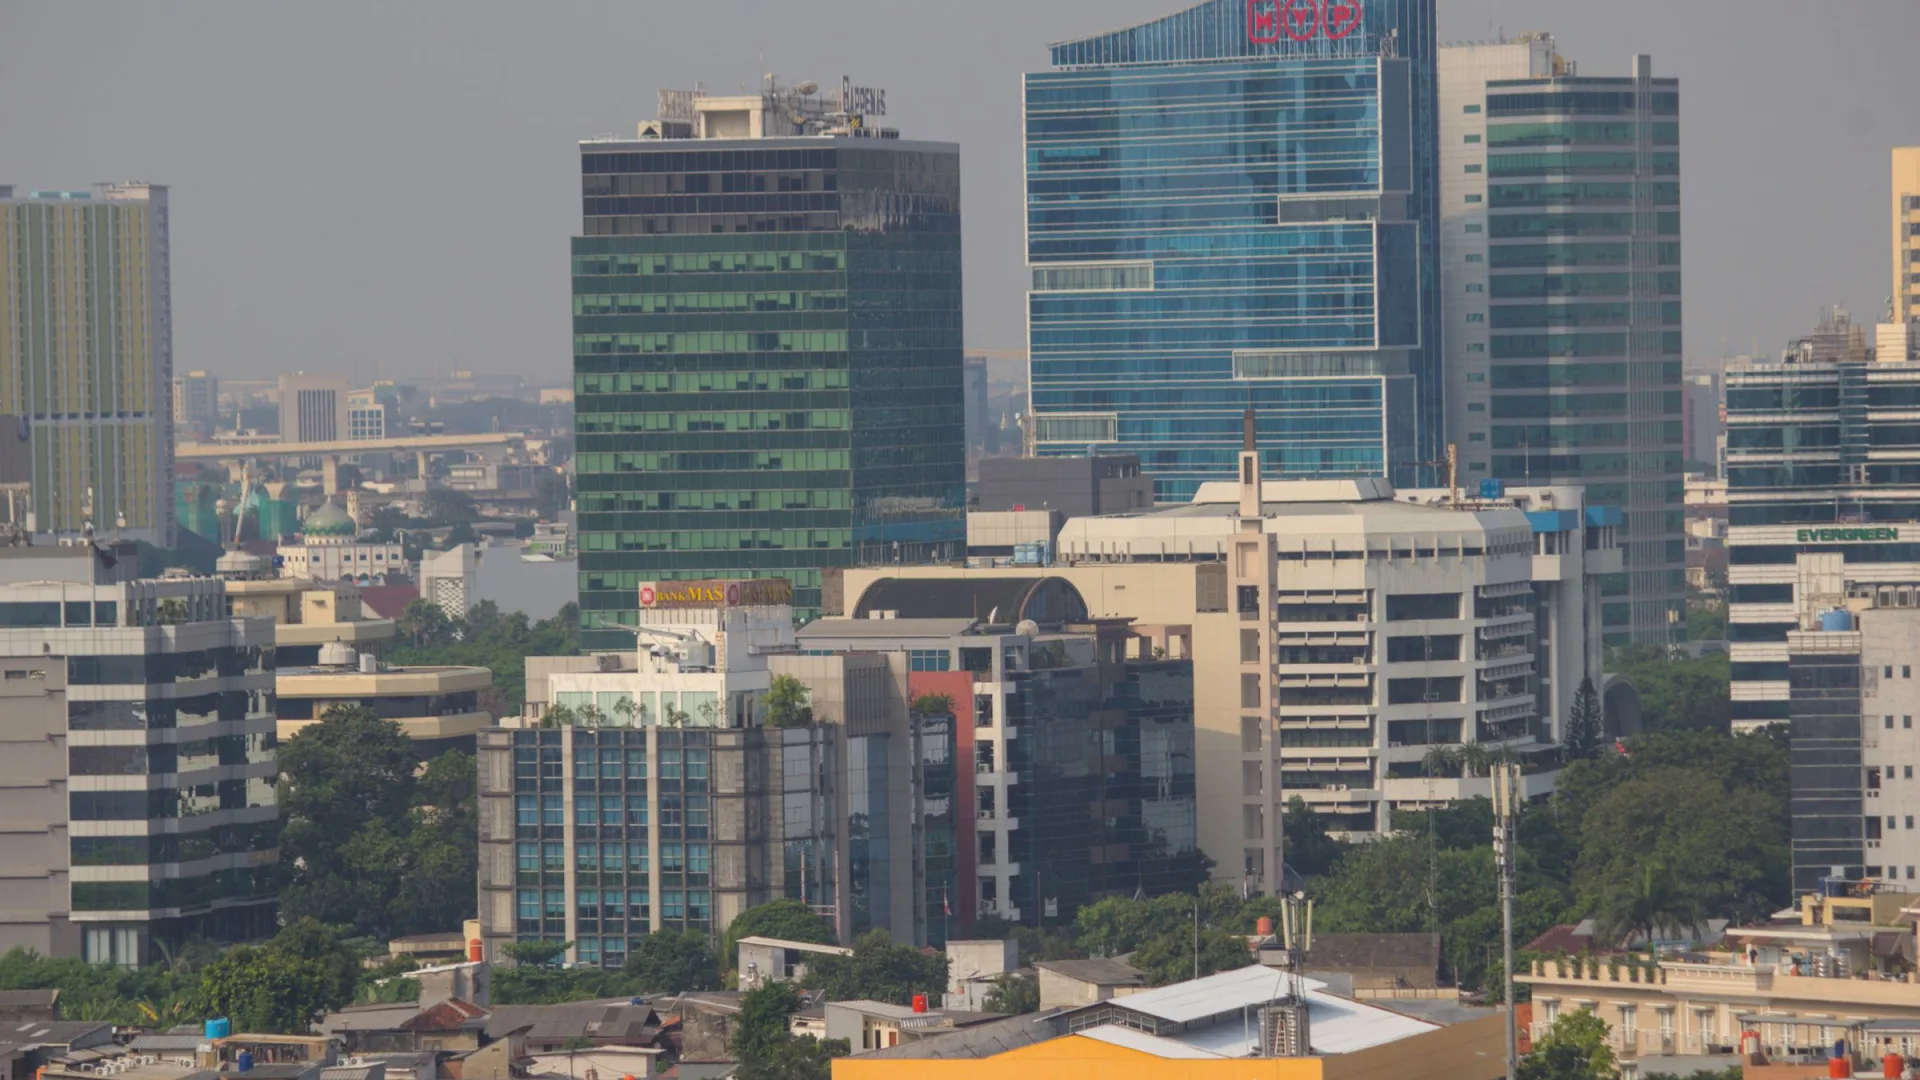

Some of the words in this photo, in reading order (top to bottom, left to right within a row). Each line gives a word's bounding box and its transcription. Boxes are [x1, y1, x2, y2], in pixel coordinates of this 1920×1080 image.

[1796, 527, 1899, 542] EVERGREEN
[656, 591, 686, 602] BANK
[687, 586, 725, 602] MAS
